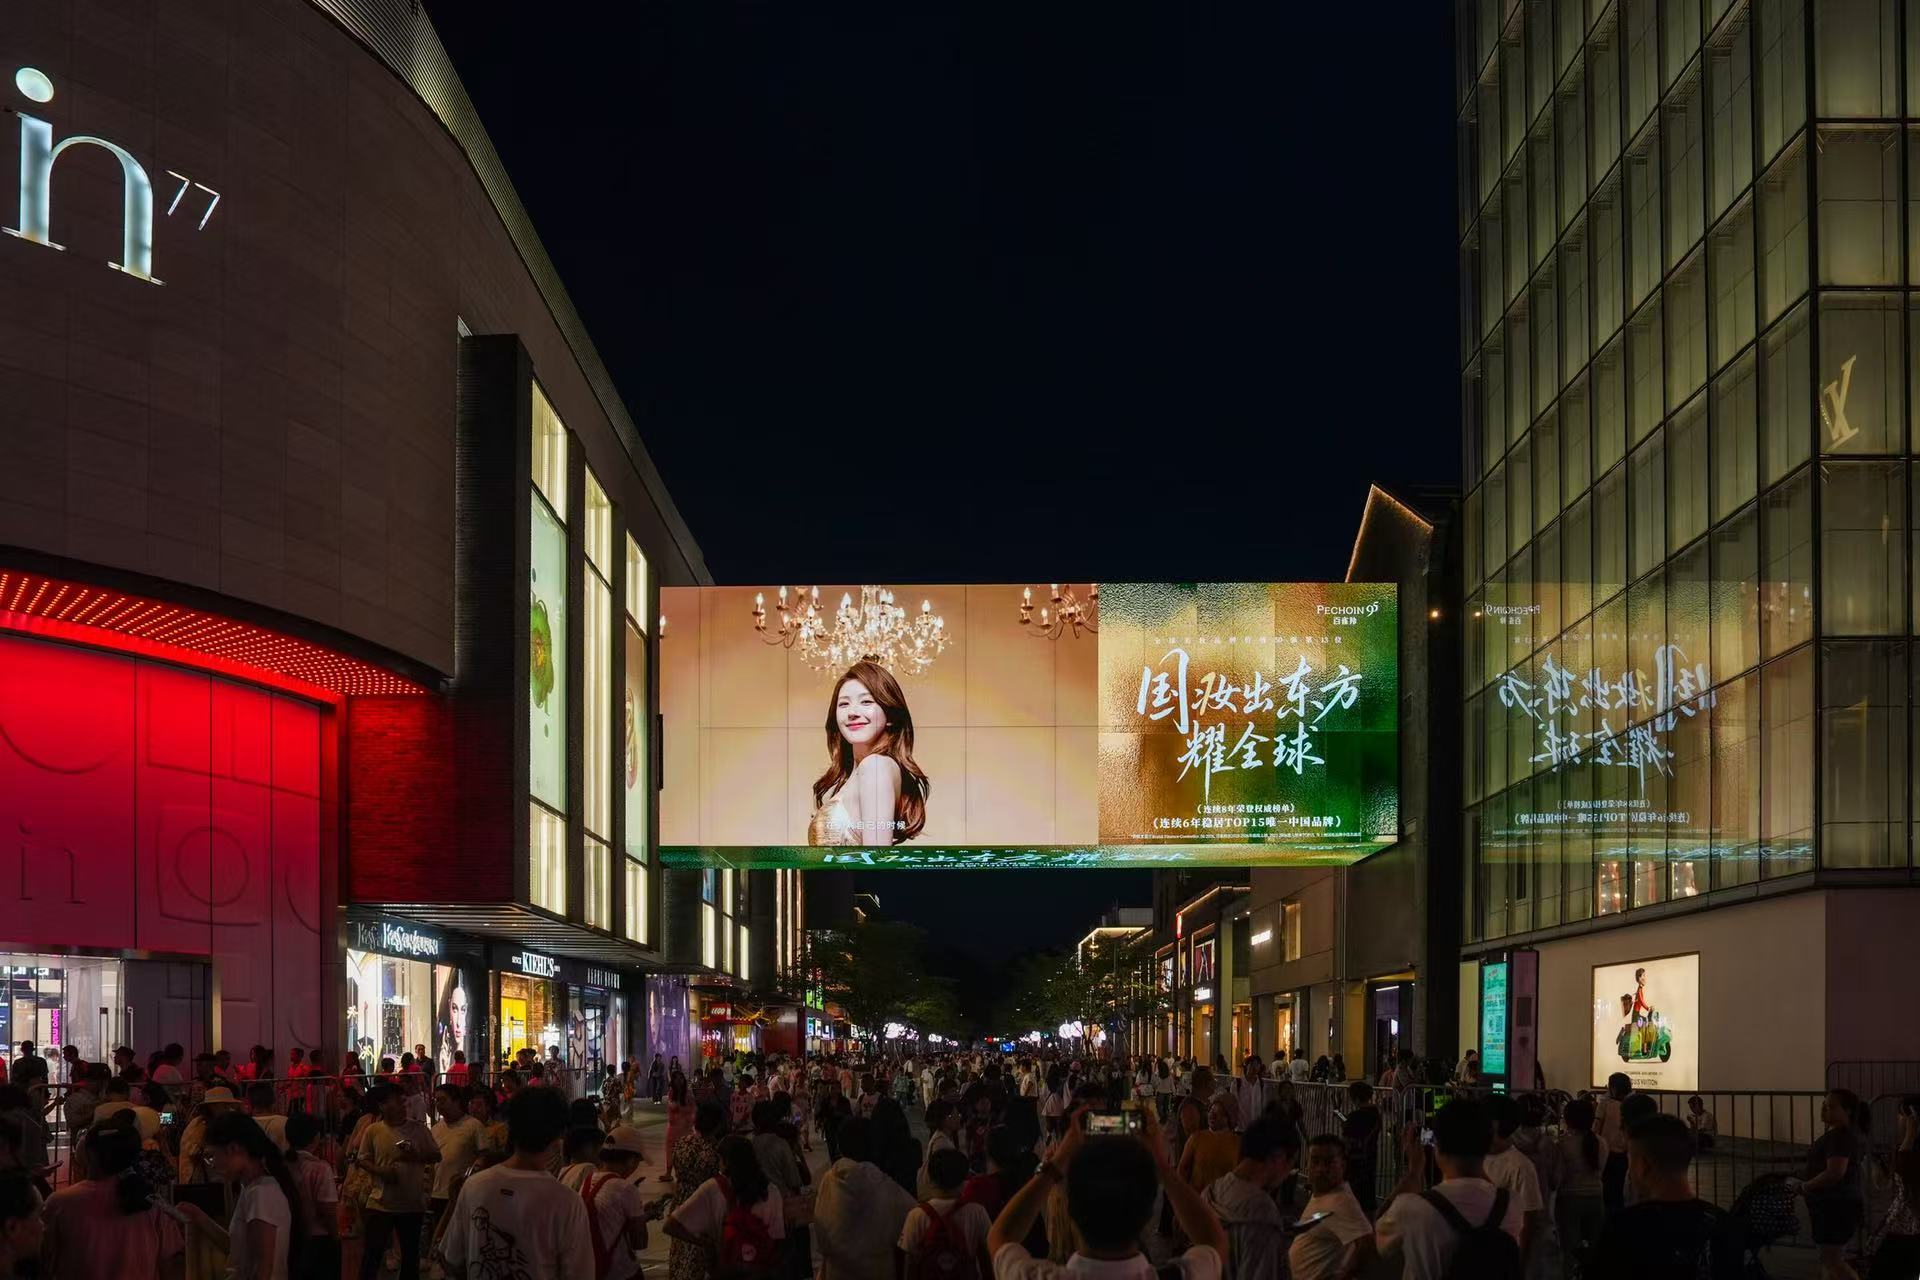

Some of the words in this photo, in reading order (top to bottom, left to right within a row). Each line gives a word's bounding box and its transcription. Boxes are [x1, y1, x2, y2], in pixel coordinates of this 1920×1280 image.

[1, 66, 167, 286] in
[165, 169, 221, 231] 77
[1316, 604, 1365, 615] PECHOIN
[1176, 720, 1326, 804] 耀全球
[826, 820, 907, 831] 在自己的时候
[522, 951, 555, 978] KIEHL'S
